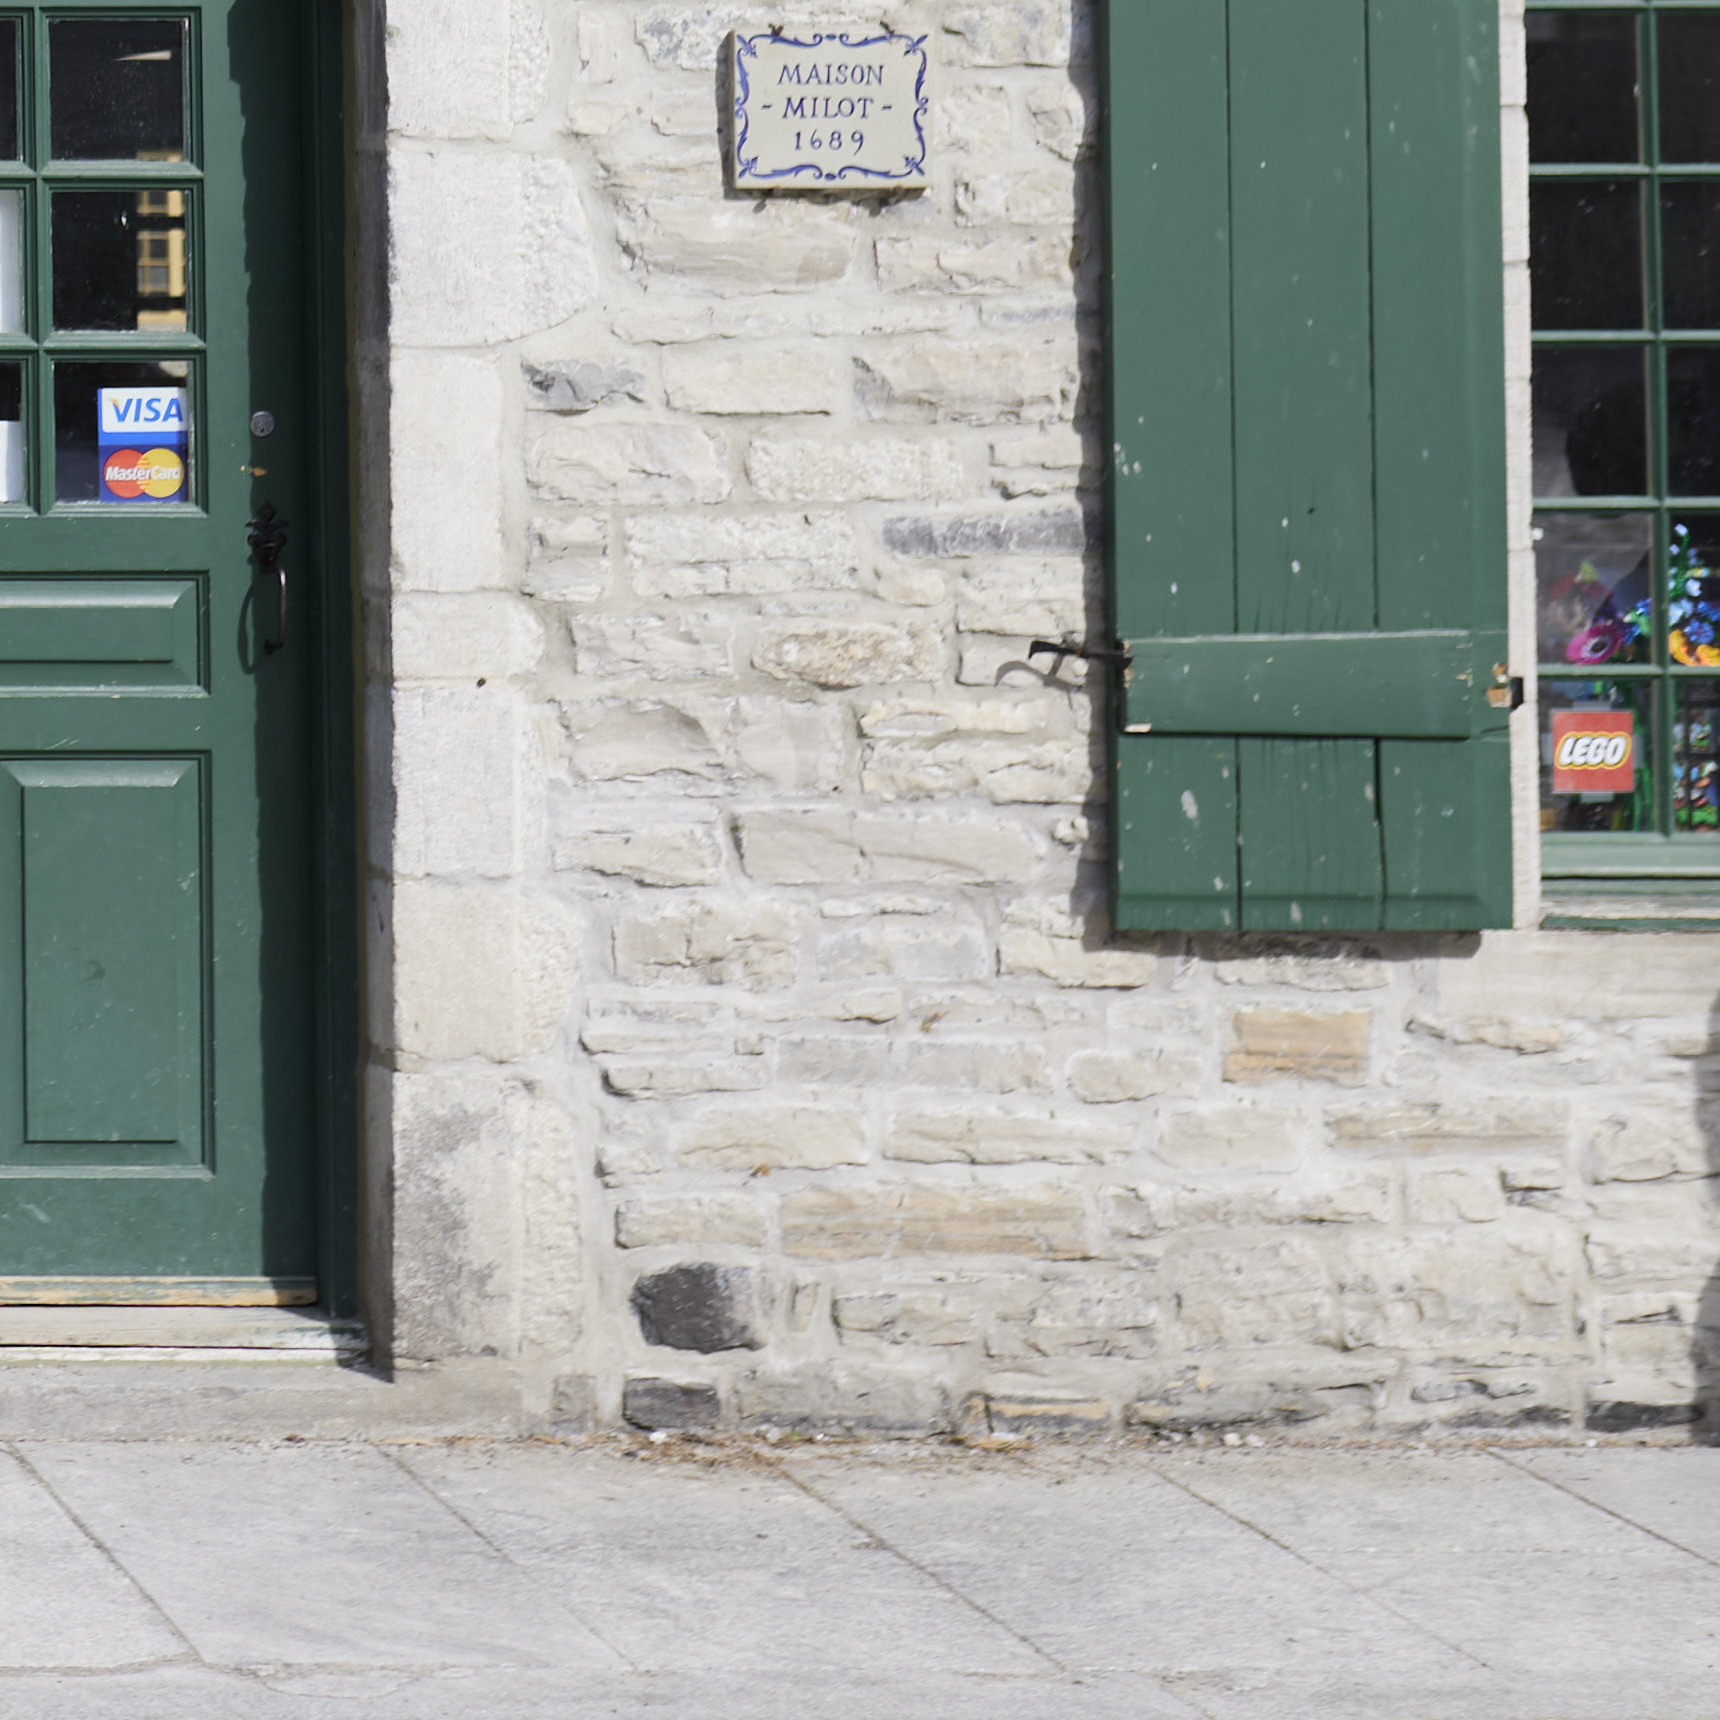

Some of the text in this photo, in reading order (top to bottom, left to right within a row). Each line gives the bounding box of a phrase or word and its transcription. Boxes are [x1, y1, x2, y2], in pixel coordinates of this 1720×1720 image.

[777, 63, 885, 86] MAISON
[781, 96, 874, 120] MILOT
[794, 128, 865, 157] 1689
[108, 397, 184, 423] VISA
[105, 464, 183, 482] MasterCard
[1557, 733, 1629, 768] LEGO
